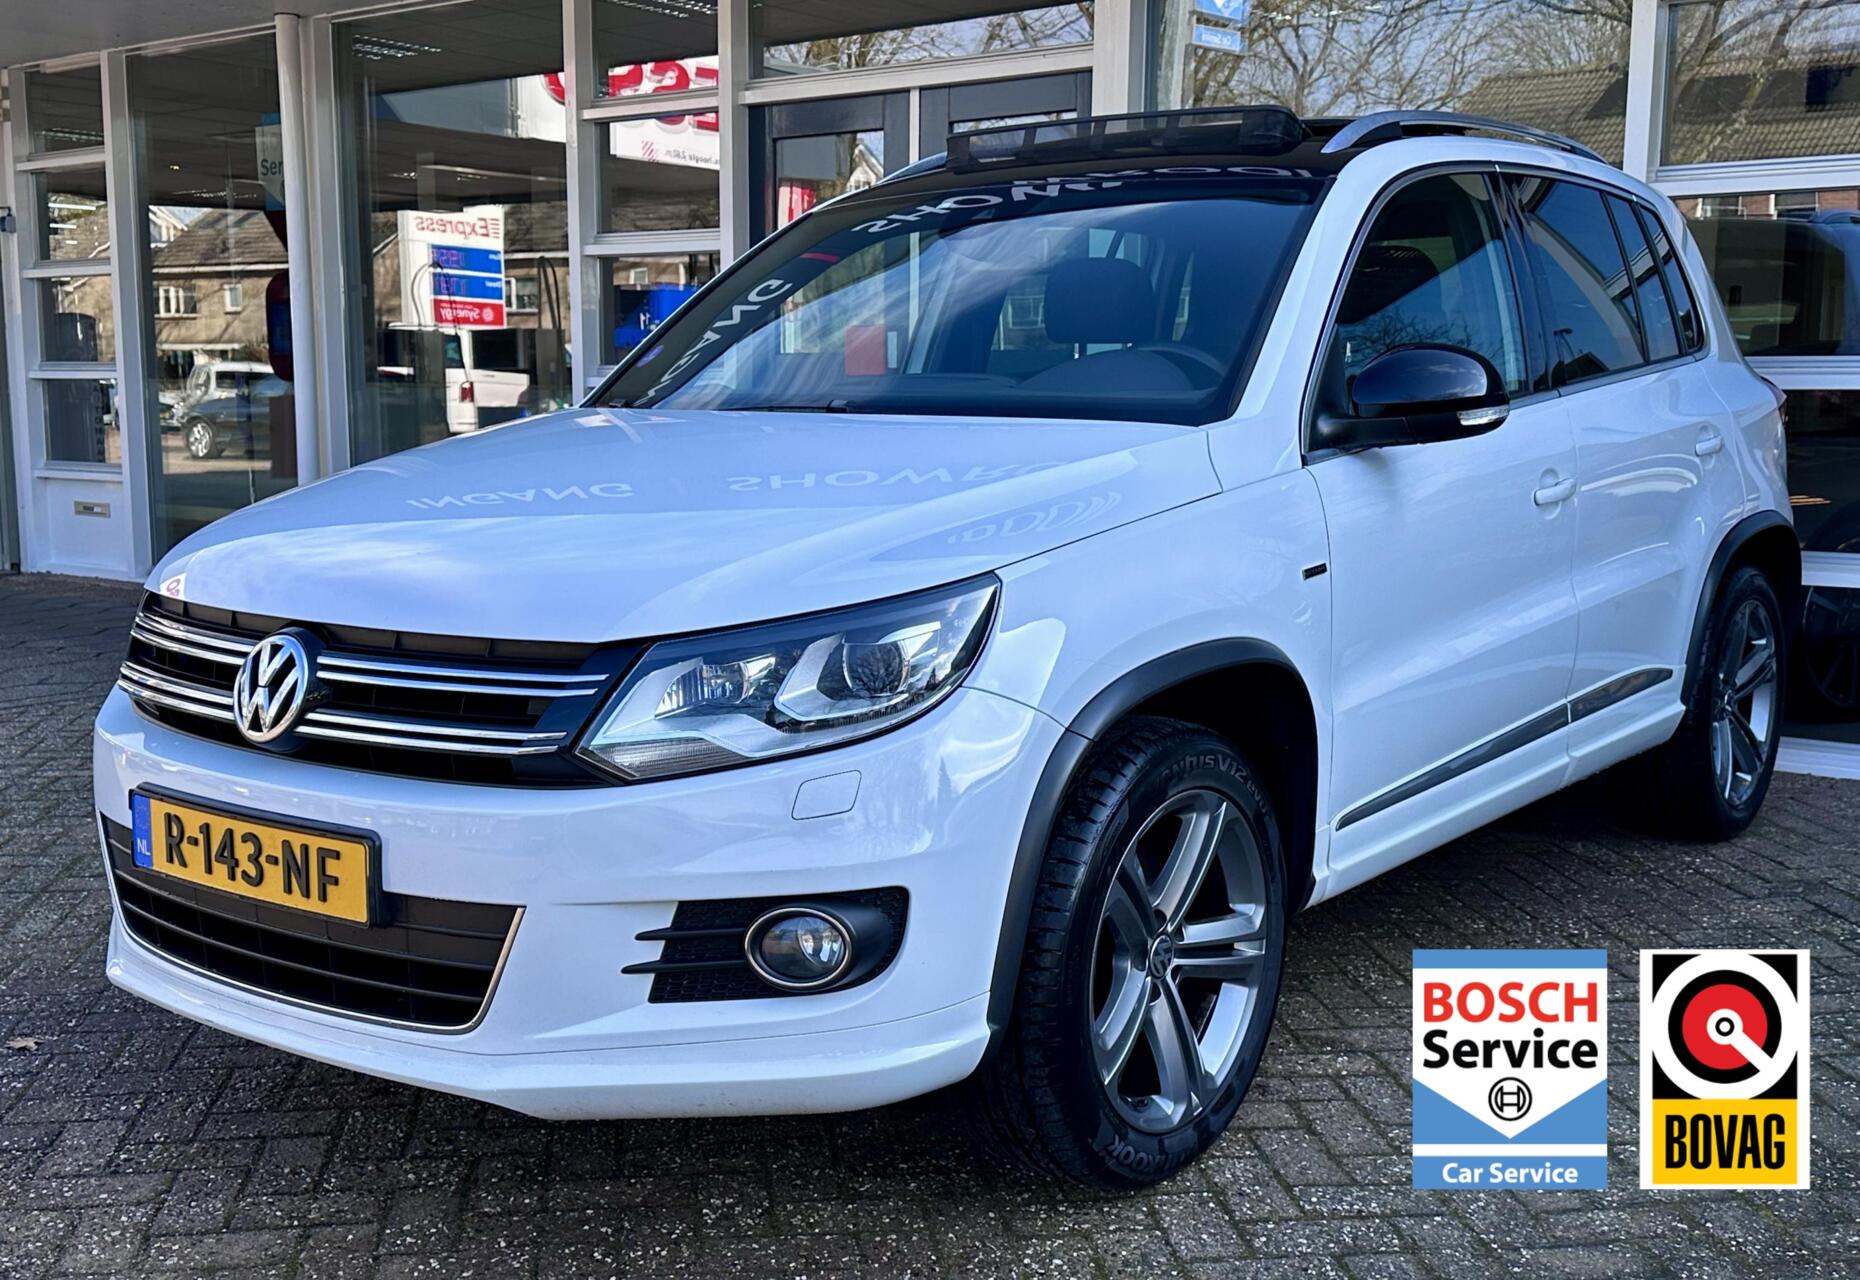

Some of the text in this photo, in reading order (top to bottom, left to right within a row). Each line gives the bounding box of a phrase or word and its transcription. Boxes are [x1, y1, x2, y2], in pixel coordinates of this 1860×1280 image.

[1217, 754, 1247, 783] V12
[136, 837, 152, 856] NL
[164, 811, 341, 903] R-143-NF
